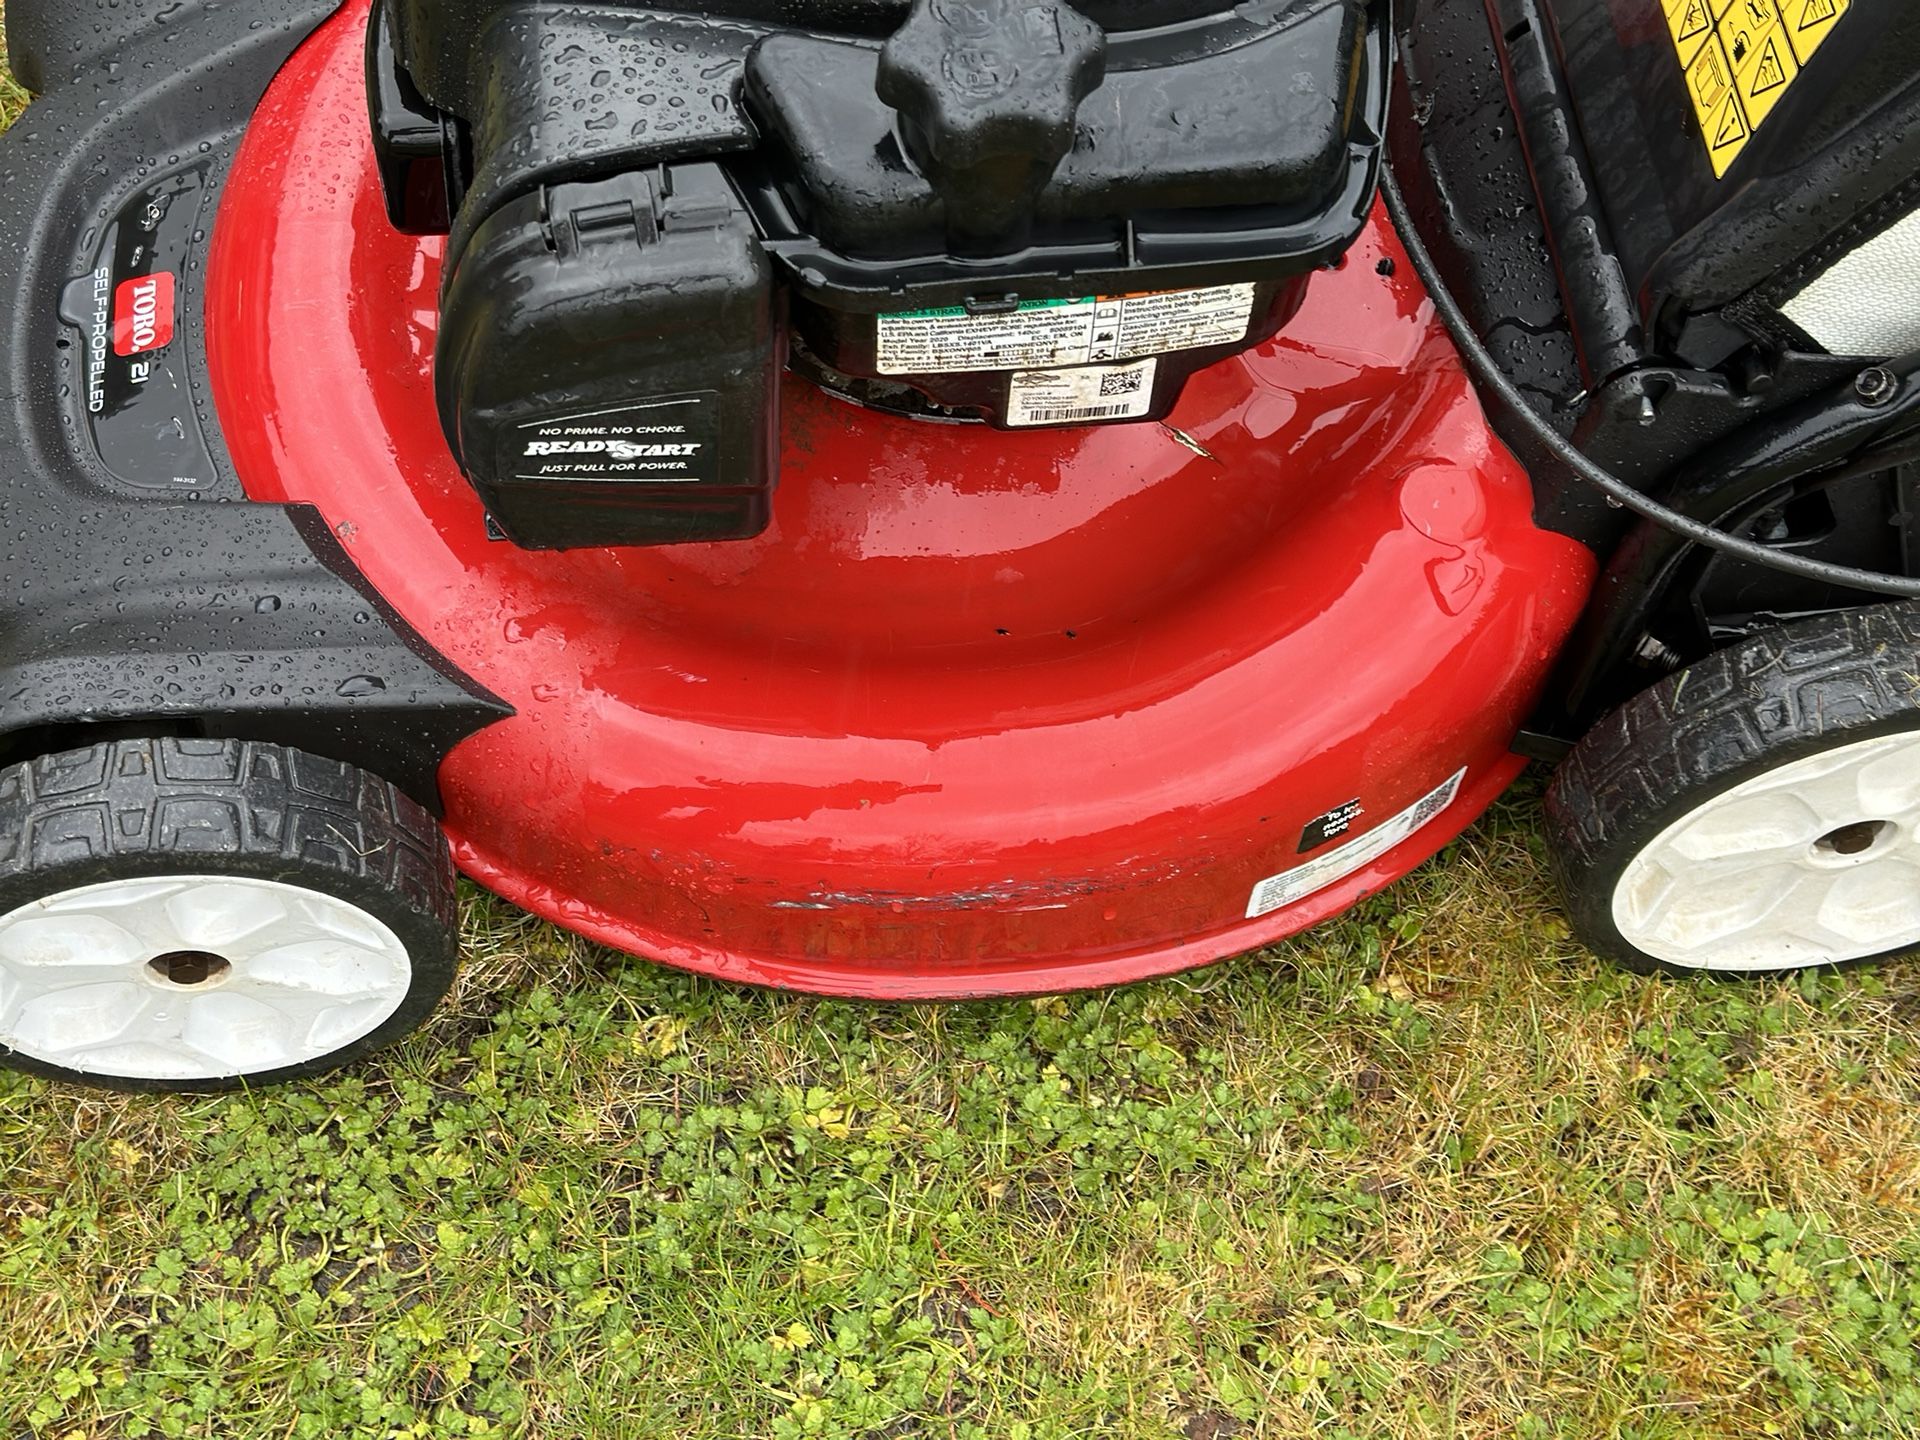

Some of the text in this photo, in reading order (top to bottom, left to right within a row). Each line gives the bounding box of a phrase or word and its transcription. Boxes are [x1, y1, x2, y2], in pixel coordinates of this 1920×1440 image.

[1148, 296, 1163, 304] and
[1165, 294, 1188, 303] follow
[1191, 288, 1231, 299] Operating
[1124, 304, 1172, 314] Instructions
[1174, 300, 1200, 309] before
[1201, 294, 1233, 304] running
[1045, 314, 1069, 323] engine
[1070, 311, 1093, 319] meets
[1122, 322, 1157, 331] Gasoline
[1213, 310, 1235, 318] Allow
[1124, 312, 1160, 321] servicing
[930, 327, 965, 336] California
[957, 331, 1015, 342] Displacement:
[1121, 330, 1148, 339] engine
[89, 267, 108, 413] SELF-PROPELLED
[901, 343, 929, 351] Family:
[131, 362, 149, 383] 21
[539, 425, 686, 436] NO PRIME. NO CHOKE.
[539, 462, 688, 474] JUST PULL FOR POWER.
[1324, 822, 1349, 838] Toro
